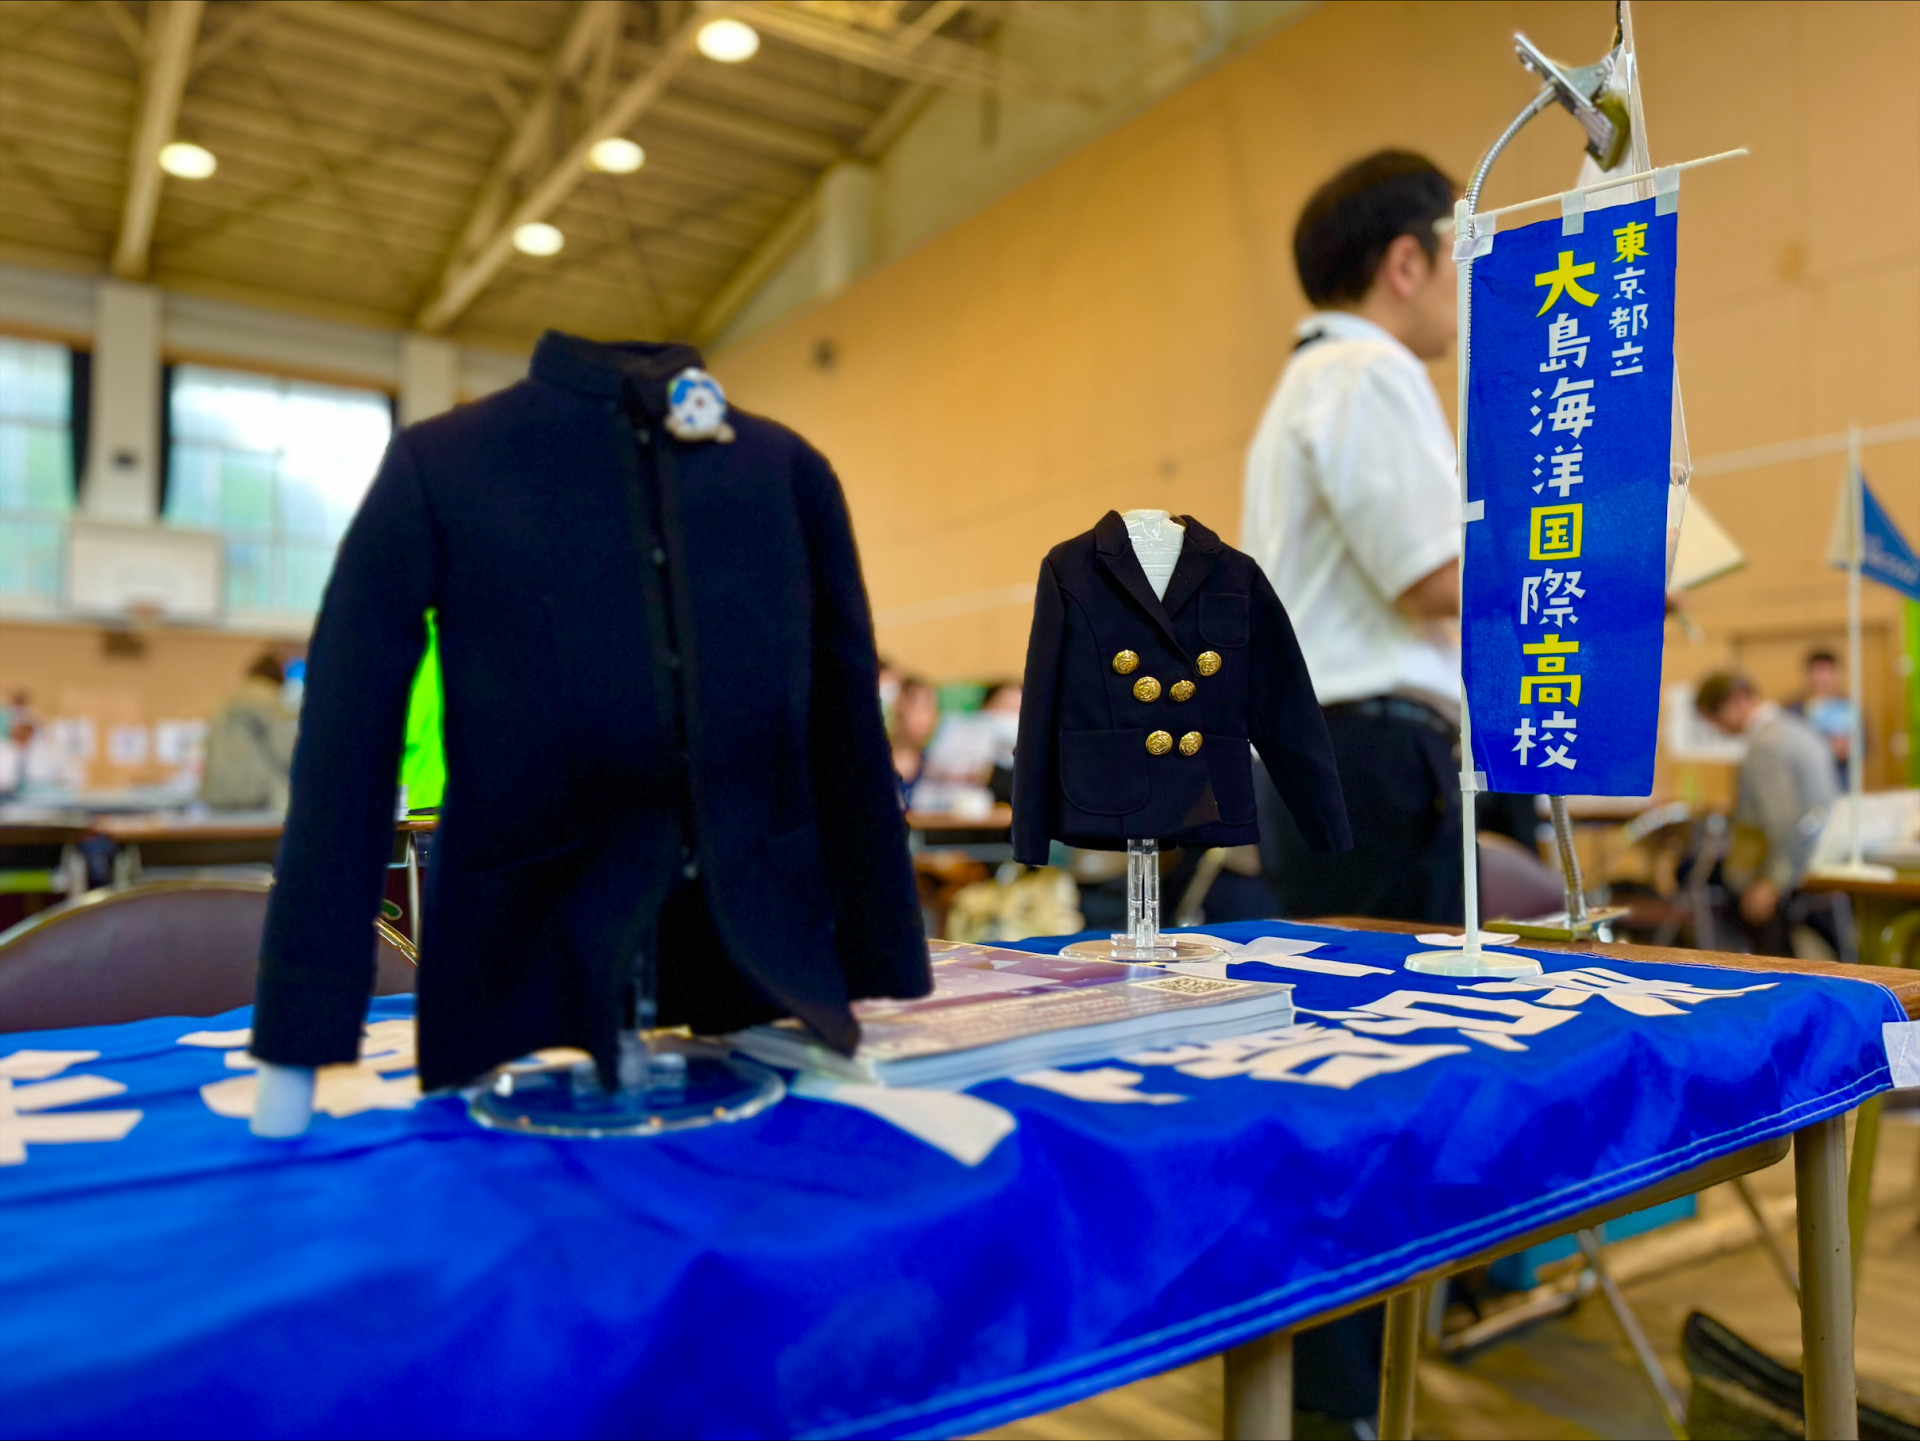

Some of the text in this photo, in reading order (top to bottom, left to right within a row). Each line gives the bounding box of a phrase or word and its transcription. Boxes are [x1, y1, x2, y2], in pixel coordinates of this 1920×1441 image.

[1608, 221, 1650, 377] 東京都立
[1511, 249, 1600, 771] 大島海洋国際高校
